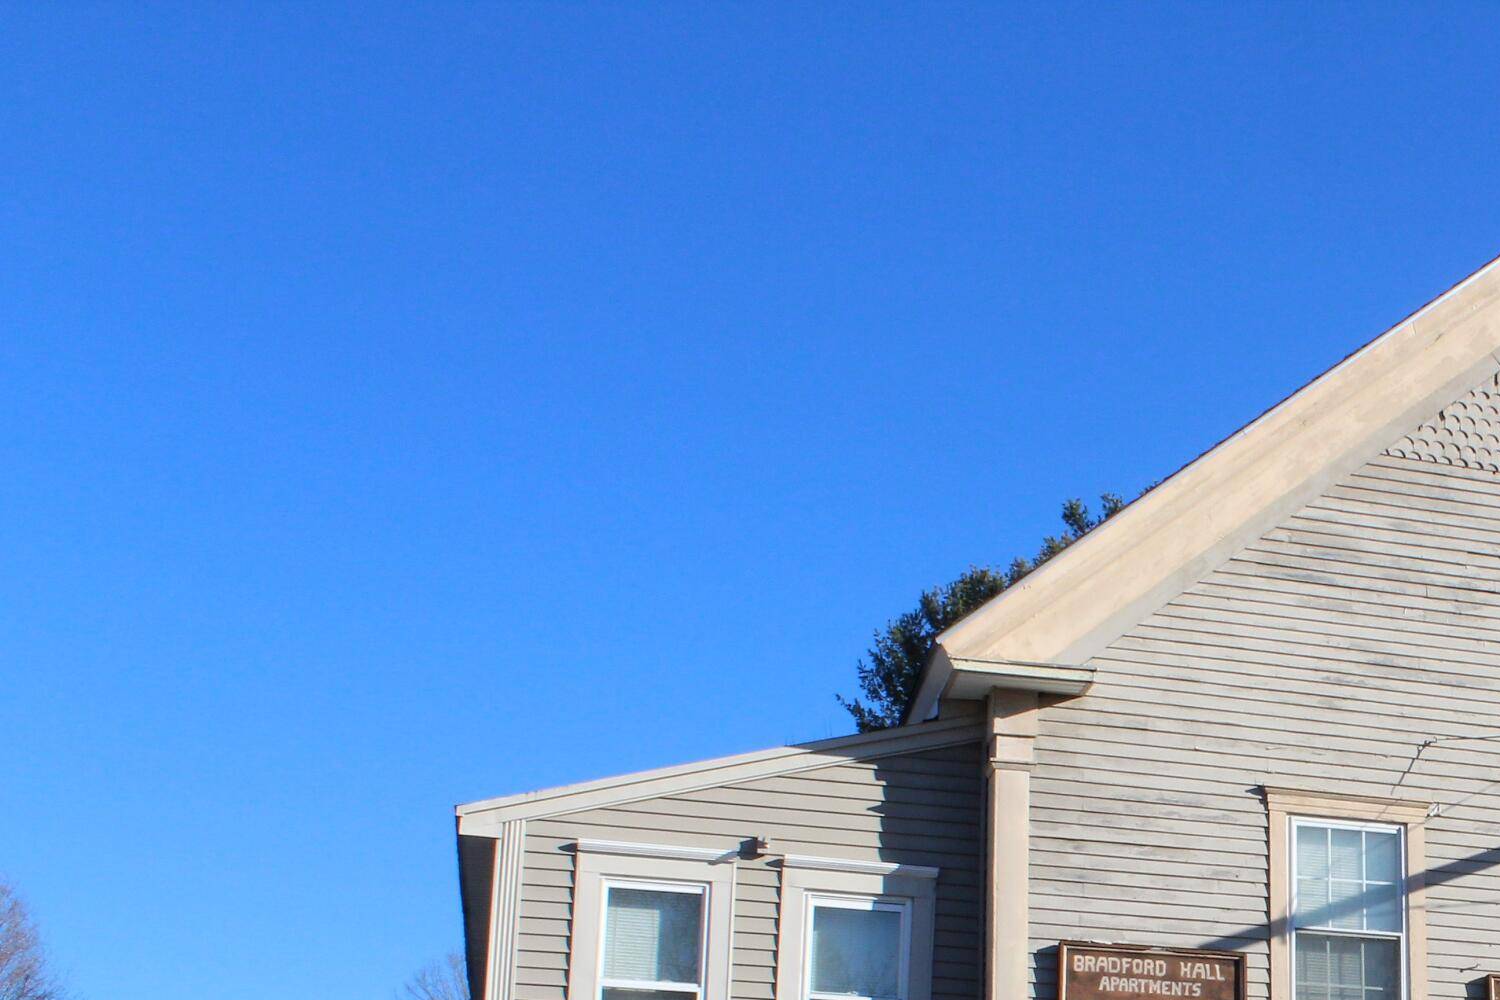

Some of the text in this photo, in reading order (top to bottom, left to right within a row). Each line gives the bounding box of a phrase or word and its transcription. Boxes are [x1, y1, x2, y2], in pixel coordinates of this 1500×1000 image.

[1073, 955, 1225, 980] BRADFORD HALL
[1099, 976, 1201, 996] APARTMENTS
